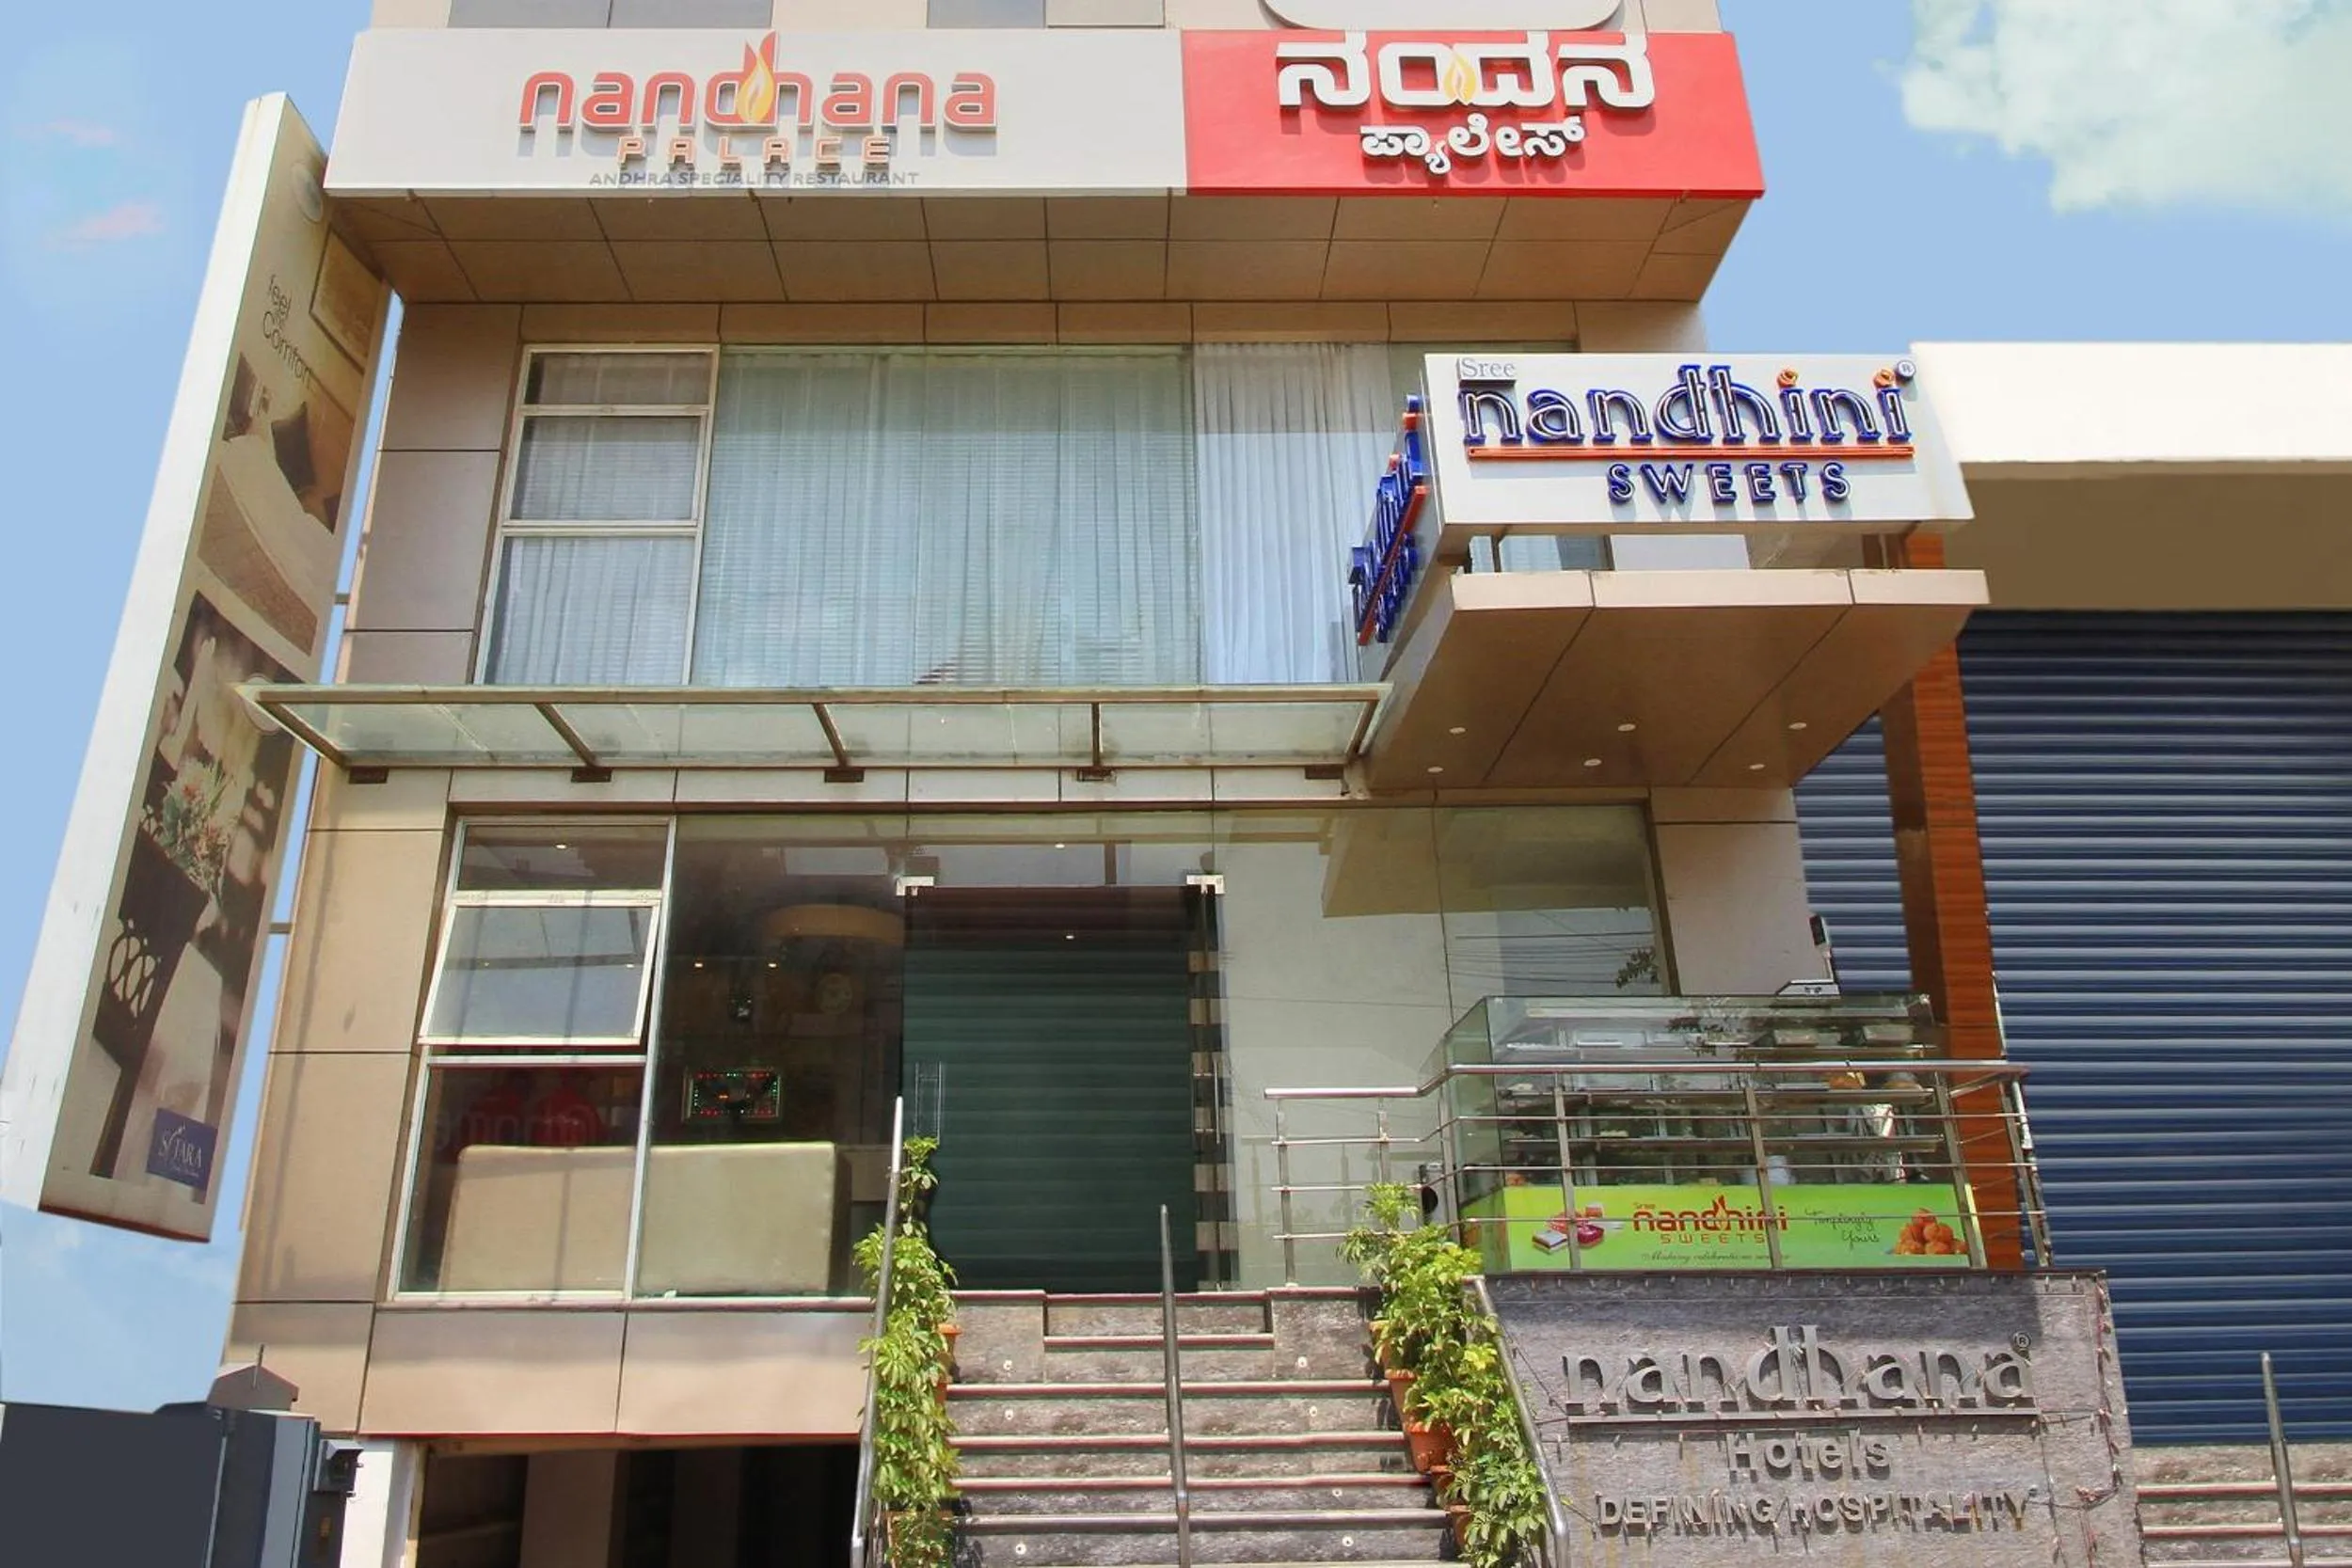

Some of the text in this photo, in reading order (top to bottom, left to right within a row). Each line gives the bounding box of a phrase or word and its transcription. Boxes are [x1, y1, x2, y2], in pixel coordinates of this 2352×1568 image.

[518, 30, 998, 130] nandhana
[1276, 29, 1656, 108] ನಂದನ
[616, 135, 892, 167] PALACE
[589, 171, 920, 185] ANDHRA SPECIALITY RESTAURANT
[1461, 356, 1516, 377] Sree
[1459, 364, 1911, 444] nandhini
[1608, 462, 1851, 504] SWEETS
[1661, 1233, 1766, 1243] SWEETS
[1561, 1324, 2037, 1414] nandhana
[1725, 1429, 1891, 1473] Hotels
[1599, 1496, 1776, 1526] DEFINING
